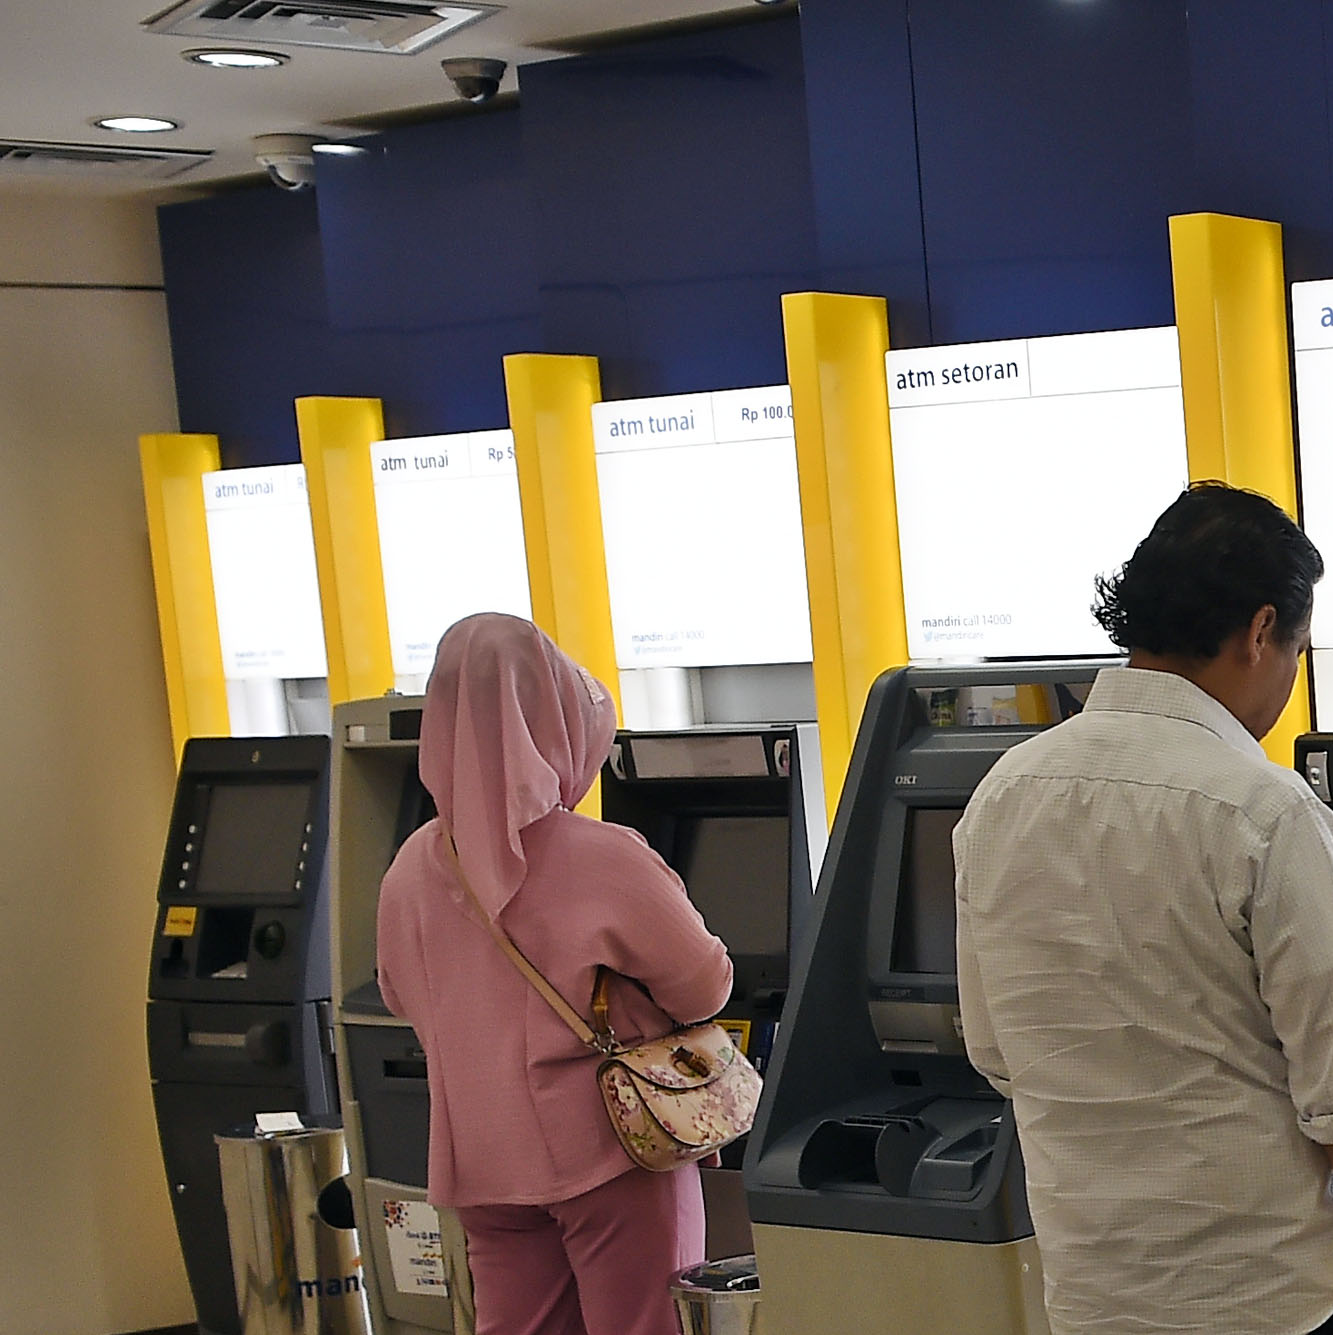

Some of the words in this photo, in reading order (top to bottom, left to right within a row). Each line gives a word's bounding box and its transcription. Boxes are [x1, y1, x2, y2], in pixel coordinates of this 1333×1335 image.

[896, 367, 935, 390] atm
[941, 358, 1019, 385] setoran
[609, 417, 644, 437] atm
[649, 409, 695, 434] tunai
[741, 406, 758, 423] Rp
[380, 456, 407, 471] atm
[414, 449, 449, 470] tunai
[488, 447, 504, 462] Rp
[215, 484, 239, 498] atm
[242, 477, 274, 496] tunai
[921, 615, 961, 628] mandiri
[982, 613, 1012, 625] 14000
[895, 775, 918, 785] OKI
